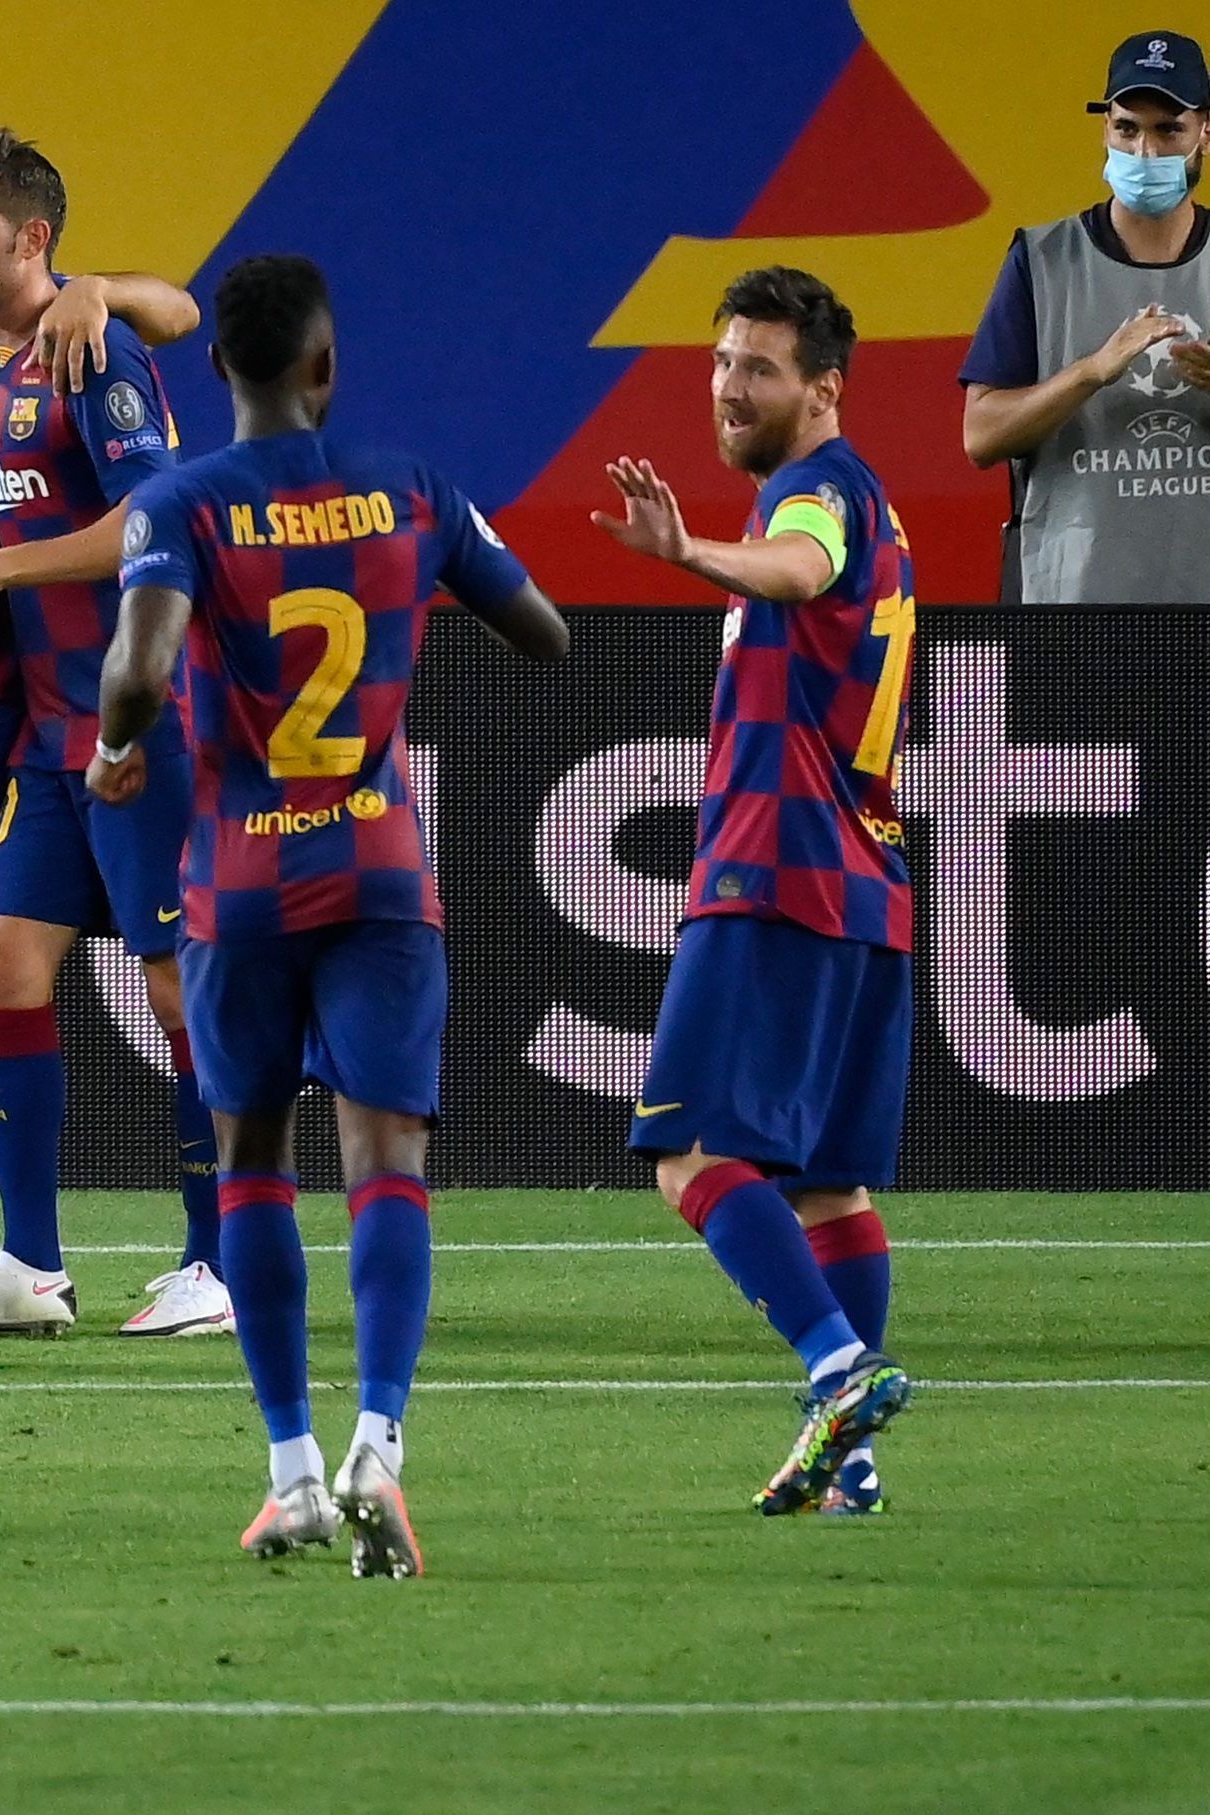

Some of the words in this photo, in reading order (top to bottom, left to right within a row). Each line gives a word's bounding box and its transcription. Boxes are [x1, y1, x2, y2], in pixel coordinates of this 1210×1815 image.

[1131, 416, 1192, 439] UEFA
[267, 587, 367, 779] 2
[851, 588, 916, 790] 1
